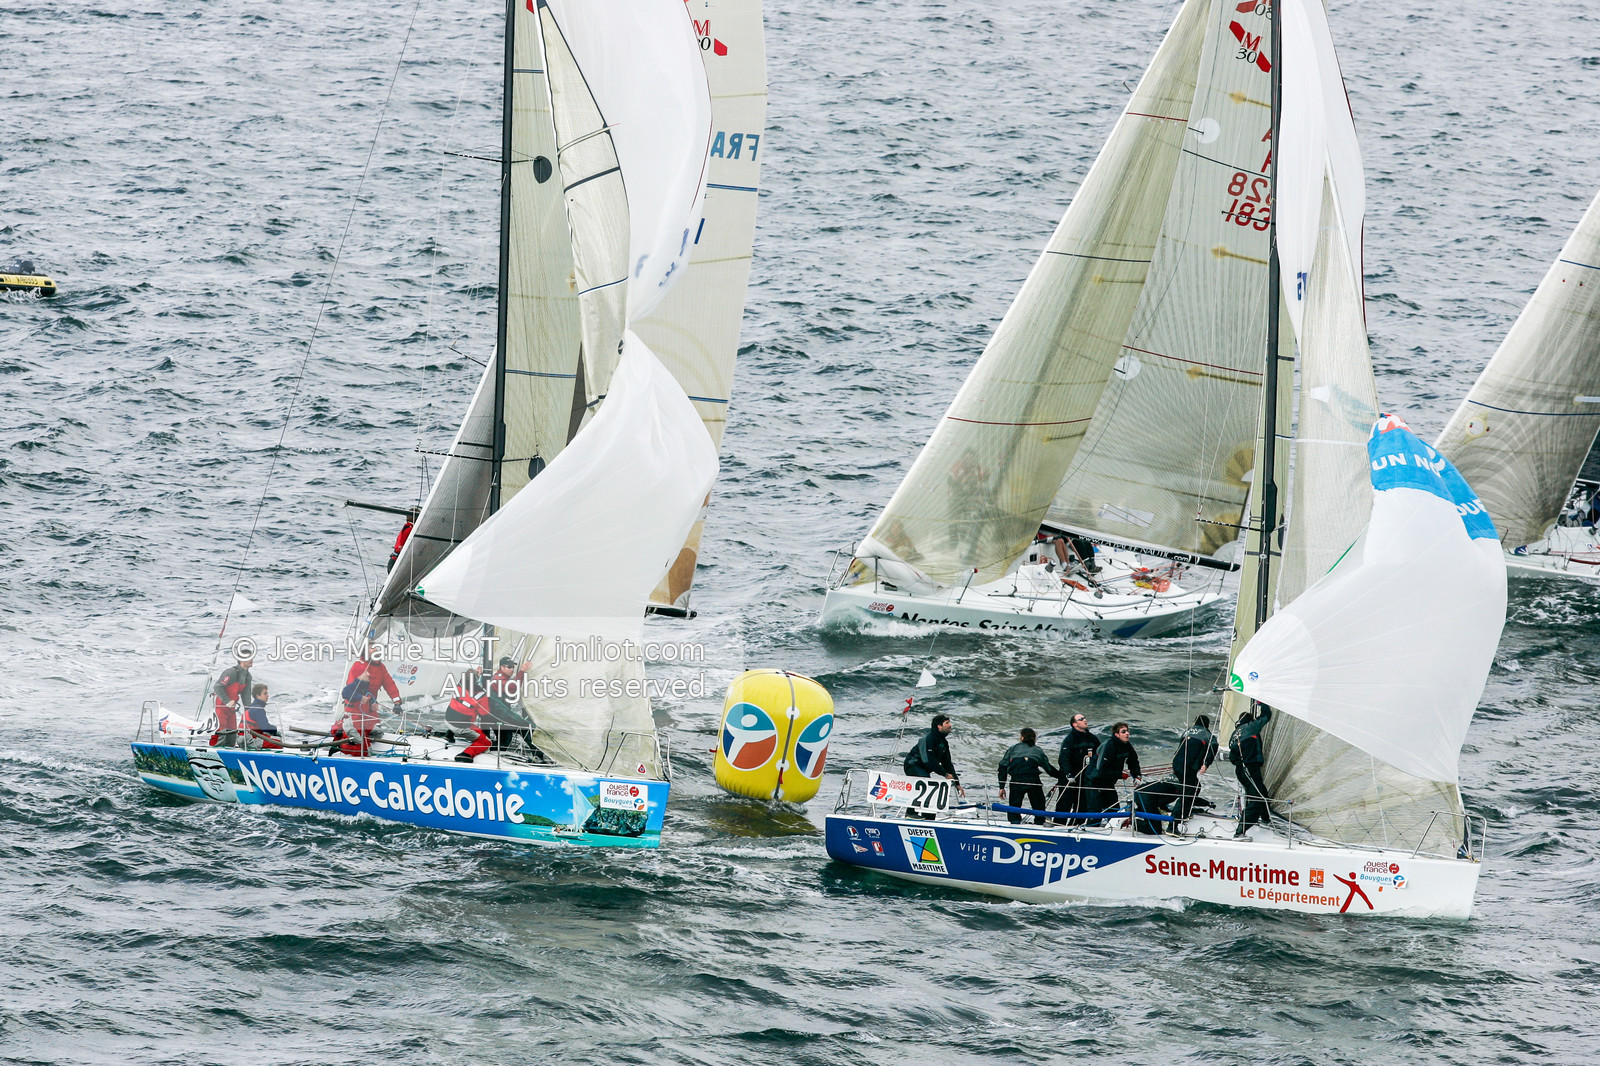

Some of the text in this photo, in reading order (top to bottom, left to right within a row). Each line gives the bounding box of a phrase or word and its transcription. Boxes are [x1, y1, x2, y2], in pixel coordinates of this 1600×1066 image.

[1235, 47, 1258, 64] 30
[1371, 452, 1407, 471] UN
[237, 757, 525, 824] Nouvelle-Calédonie
[911, 780, 949, 810] 270
[907, 828, 935, 838] DIEPPE
[959, 842, 988, 854] Ville
[972, 835, 1099, 886] Dieppe
[973, 853, 987, 862] de
[1366, 860, 1388, 868] ouest
[912, 862, 946, 873] MARITIME
[1145, 854, 1300, 887] Seine-Maritime
[1363, 864, 1388, 874] france
[1359, 873, 1392, 882] Bouygues
[1240, 886, 1341, 907] Le Département
